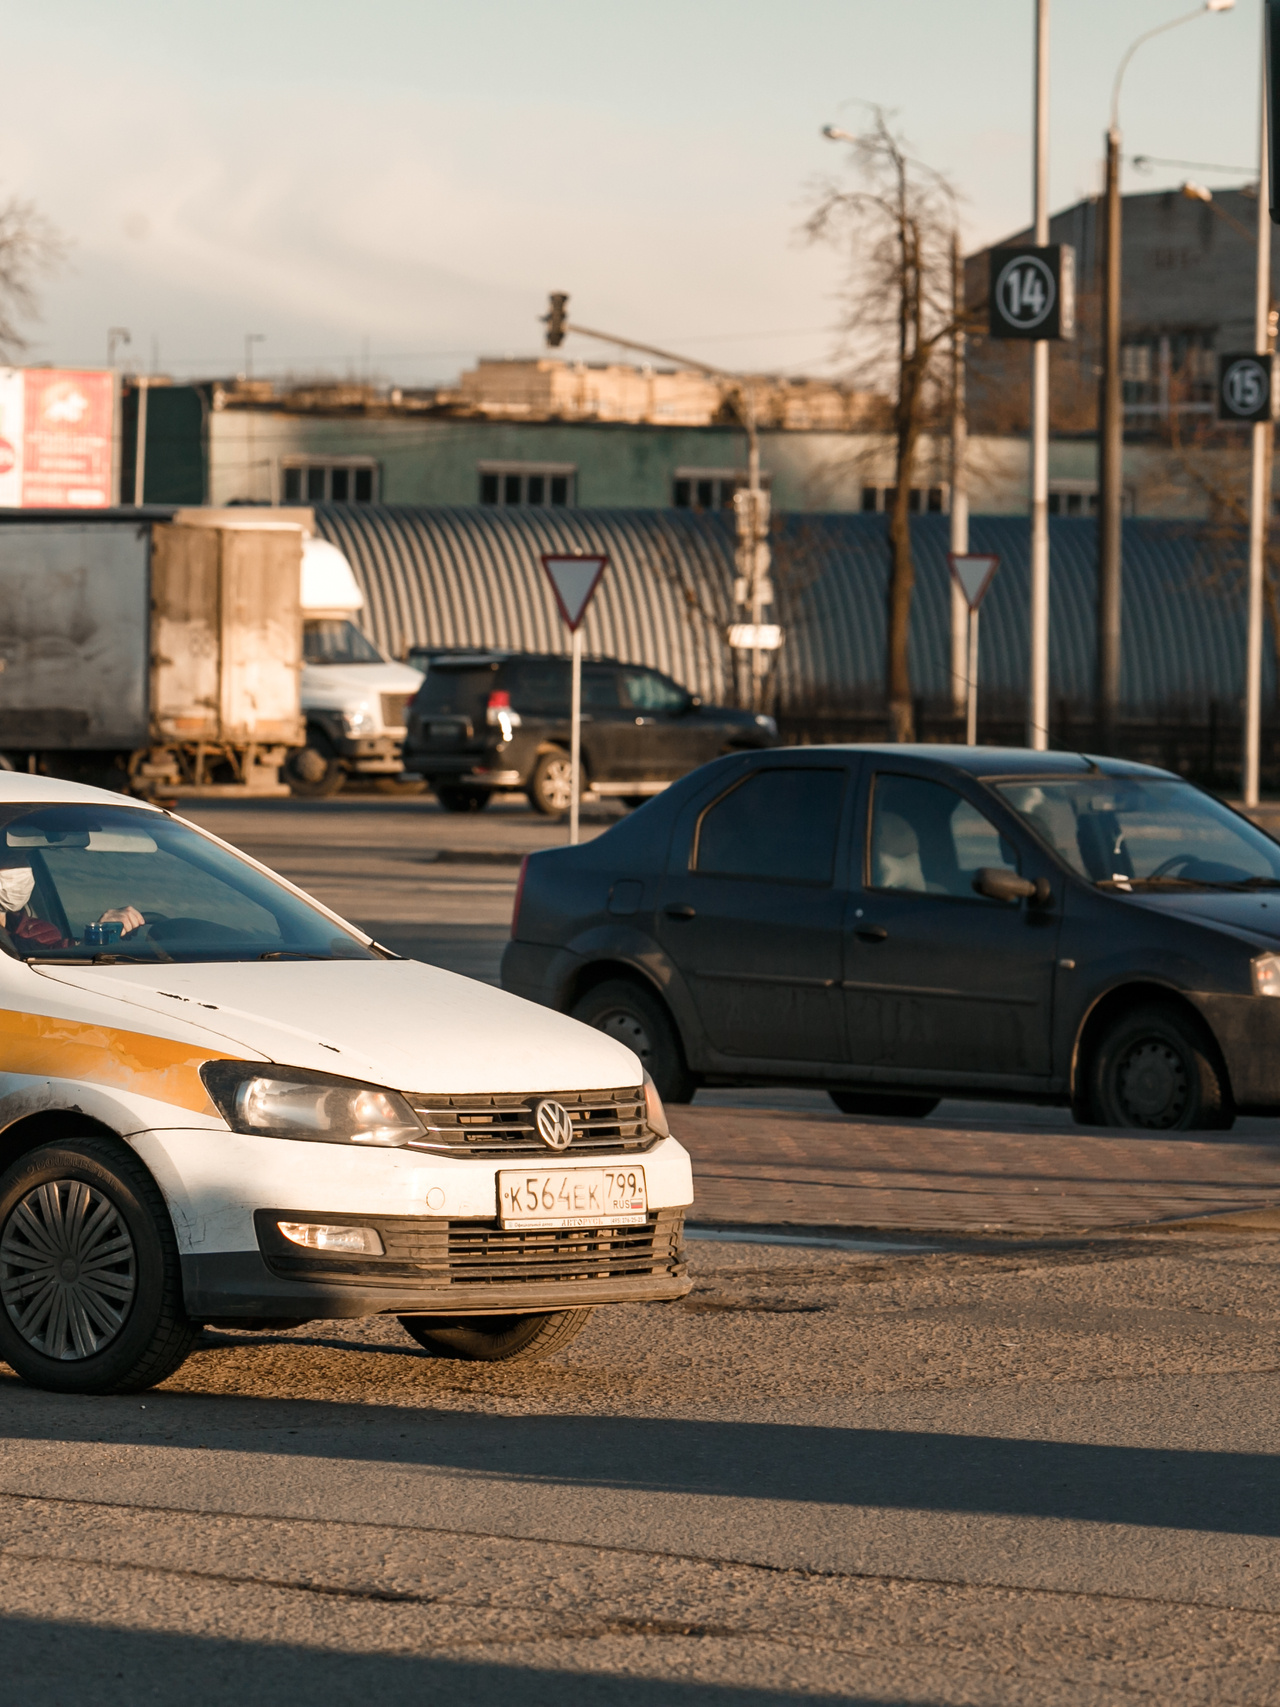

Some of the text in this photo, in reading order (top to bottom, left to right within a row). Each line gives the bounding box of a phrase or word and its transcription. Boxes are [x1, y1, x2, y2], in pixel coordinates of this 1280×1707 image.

[1007, 267, 1045, 315] 14
[1232, 369, 1260, 403] 15
[605, 1172, 637, 1198] 799
[613, 1199, 631, 1210] RUS
